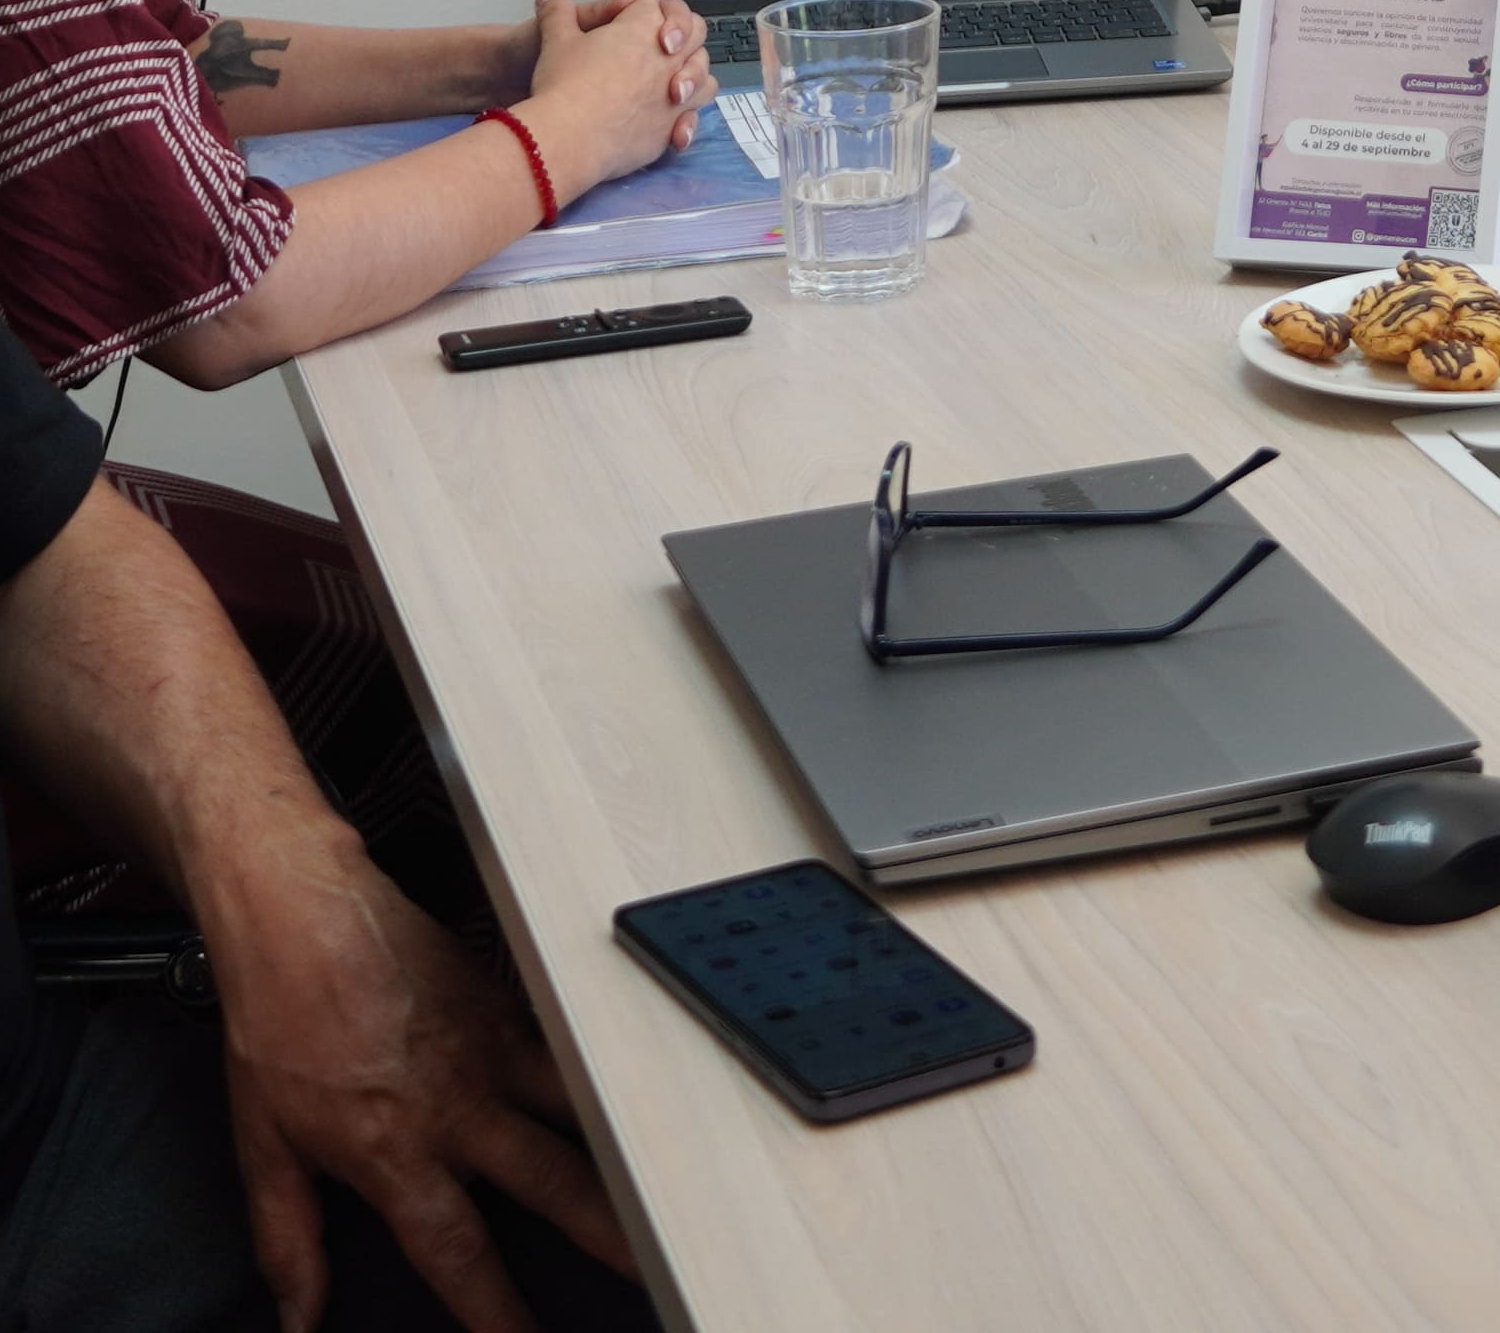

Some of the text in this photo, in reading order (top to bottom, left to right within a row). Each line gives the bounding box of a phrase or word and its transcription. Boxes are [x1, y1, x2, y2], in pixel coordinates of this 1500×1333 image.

[1437, 80, 1483, 91] participar?
[1310, 125, 1425, 142] Disponible desde el
[1301, 139, 1430, 158] 4 al 29 de septiembre
[1365, 821, 1432, 845] ThinkPad
